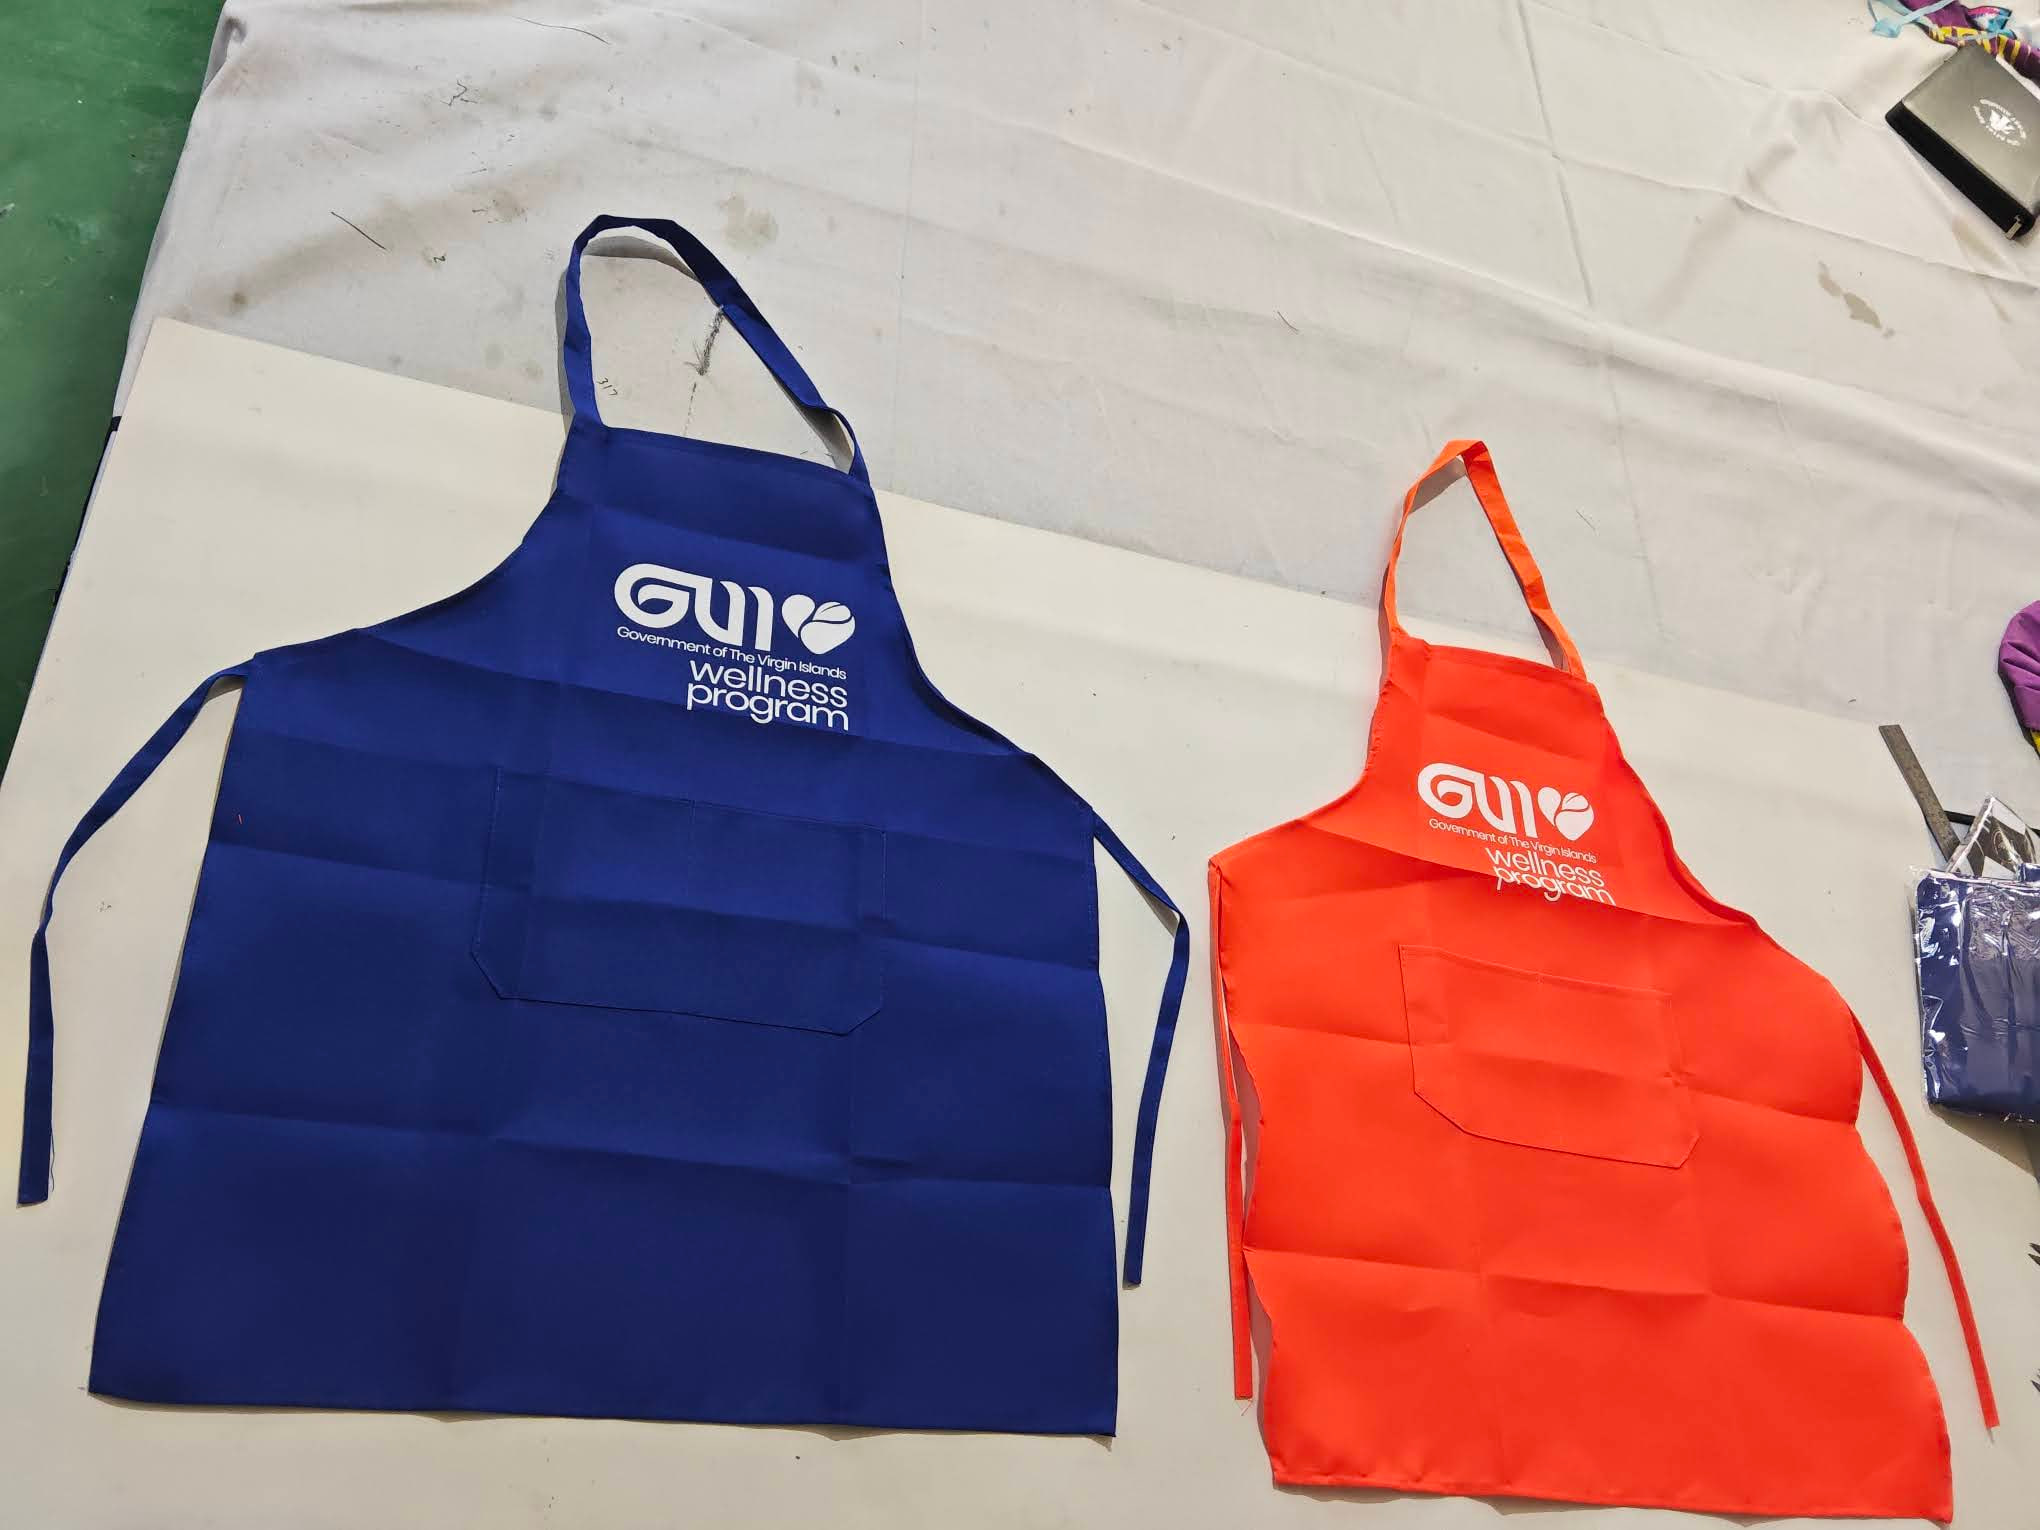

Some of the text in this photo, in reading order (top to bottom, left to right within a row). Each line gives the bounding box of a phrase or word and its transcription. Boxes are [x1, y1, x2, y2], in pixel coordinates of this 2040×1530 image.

[617, 626, 847, 680] Government of The Virgin Islands
[687, 682, 849, 731] program
[689, 660, 848, 708] wellness
[1428, 818, 1597, 864] Government of The Virgin Islands
[1485, 847, 1605, 888] wellness
[1493, 866, 1616, 905] program
